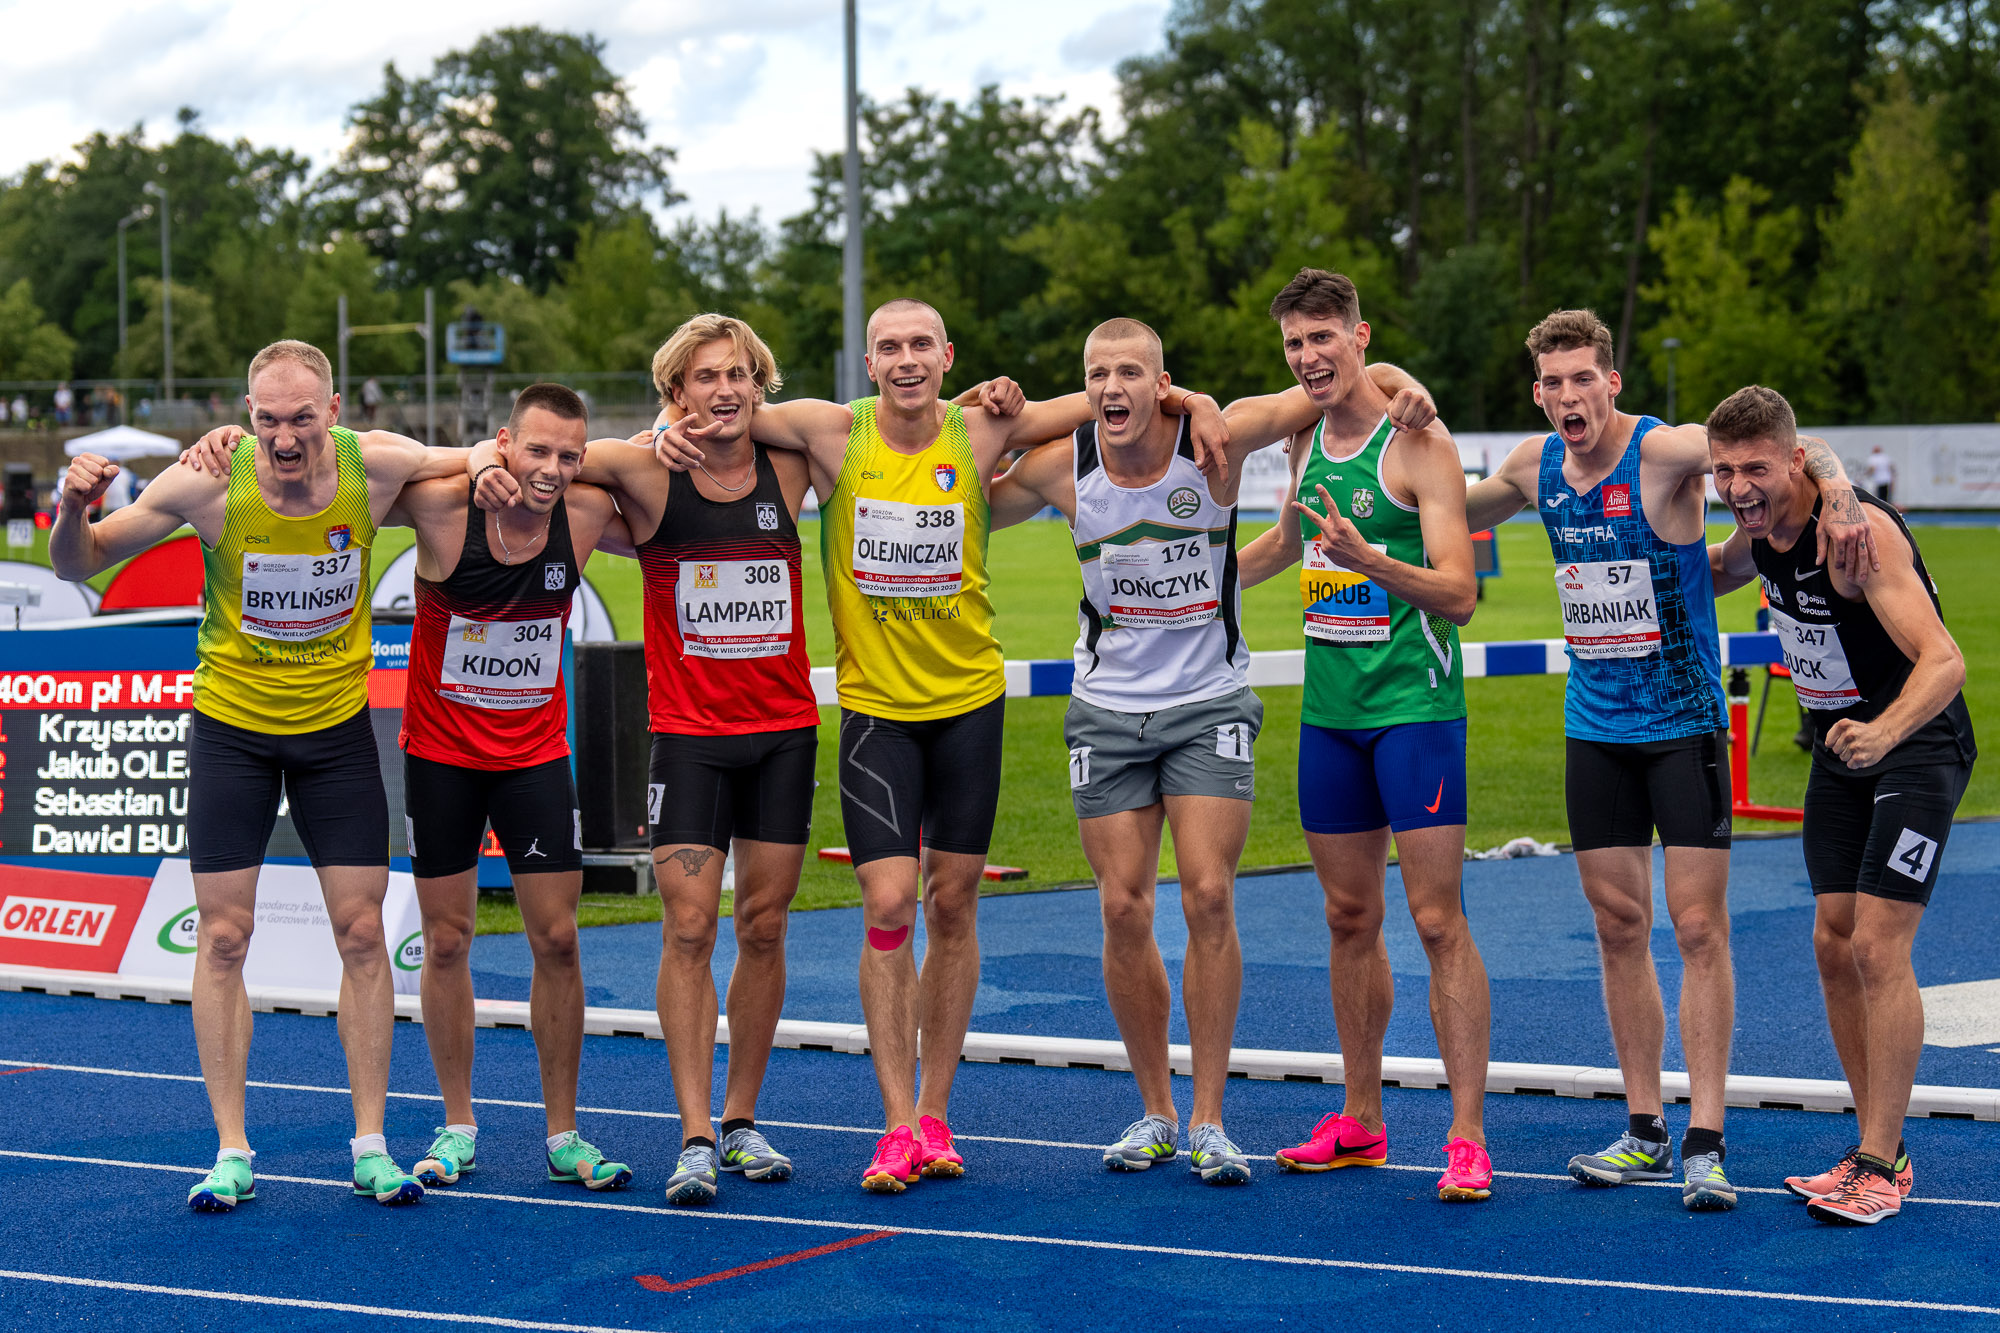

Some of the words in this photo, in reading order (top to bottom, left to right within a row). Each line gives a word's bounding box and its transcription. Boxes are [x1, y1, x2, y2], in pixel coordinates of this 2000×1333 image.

[1171, 491, 1195, 507] RKS
[915, 510, 955, 528] 338
[1554, 525, 1617, 544] VECTRA
[858, 538, 958, 564] OLEJNICZAK
[1161, 540, 1201, 564] 176
[311, 553, 352, 577] 337
[744, 565, 781, 585] 308
[1310, 561, 1326, 569] ORLEN
[1607, 565, 1632, 585] 57
[888, 584, 940, 593] WIELKOPOLSKI
[1111, 569, 1210, 599] JOŃCZYK
[1308, 581, 1371, 605] HOŁUB
[246, 583, 354, 610] BRYLIŃSKI
[685, 600, 787, 623] LAMPART
[891, 605, 961, 622] WIELICKI
[1186, 604, 1205, 613] Polski
[1563, 599, 1653, 624] URBANIAK
[285, 620, 324, 629] Mistrzostwa
[1115, 616, 1146, 624] GORZÓW
[1146, 616, 1197, 626] WIELKOPOLSKI
[513, 624, 552, 643] 304
[1794, 626, 1826, 646] 347
[461, 653, 541, 678] KIDOŃ
[479, 697, 531, 705] WIELKOPOLSKI
[482, 688, 522, 696] Mistrzostwa
[38, 713, 192, 751] Krzysztof
[1228, 724, 1241, 756] 1
[37, 750, 120, 779] Jakub
[1074, 749, 1083, 783] 1
[33, 786, 165, 816] Sebastian
[32, 824, 132, 853] Dawid
[1898, 840, 1928, 875] 4
[301, 901, 324, 912] Bank
[3, 903, 105, 938] ORLEN
